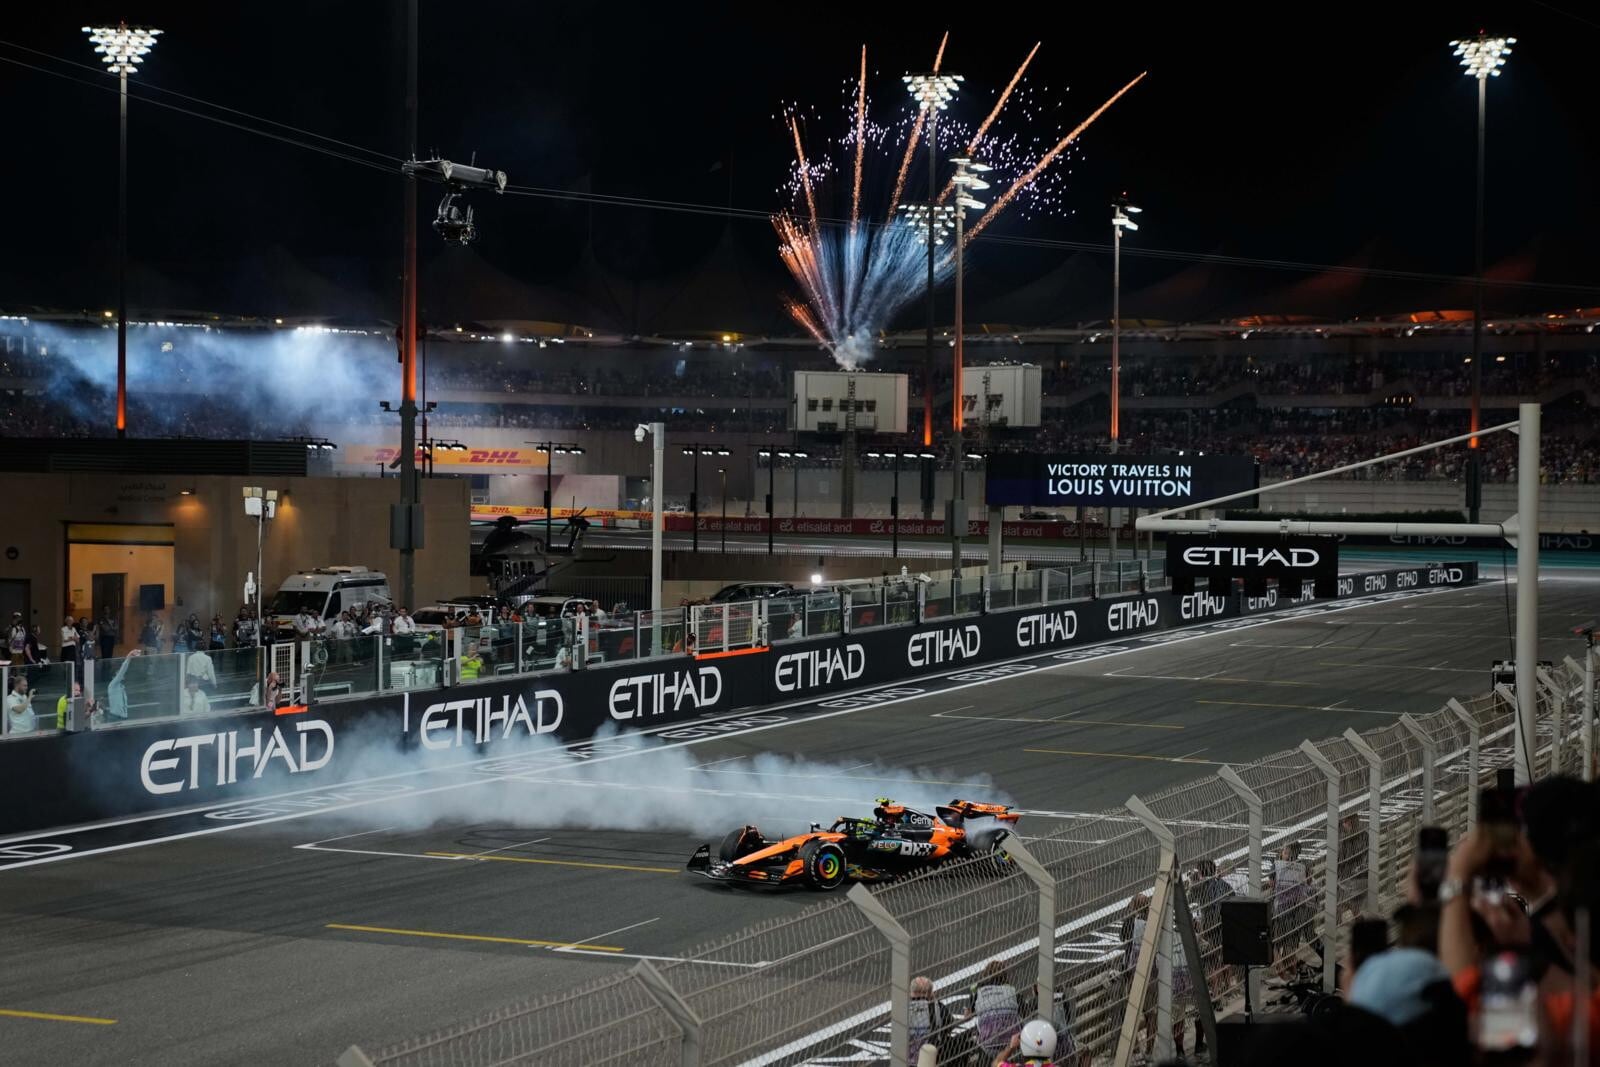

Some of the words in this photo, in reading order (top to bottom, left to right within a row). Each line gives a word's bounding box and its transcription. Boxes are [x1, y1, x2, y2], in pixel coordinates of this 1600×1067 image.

[375, 448, 427, 462] DL
[469, 450, 522, 463] DHL
[1047, 464, 1107, 476] VICTORY
[1111, 464, 1170, 477] TRAVELS
[1175, 465, 1192, 477] IN
[1048, 478, 1104, 495] LOUIS
[1109, 479, 1192, 496] VUITTON
[797, 520, 831, 532] etisalat
[832, 520, 852, 533] and
[888, 522, 924, 534] eisalat
[926, 523, 944, 534] and
[1540, 535, 1593, 549] IHAD
[1183, 546, 1319, 567] ETIHAD
[1364, 574, 1387, 592] ETIHAD
[1397, 571, 1418, 588] ETIHAD
[1429, 568, 1463, 583] ETIHAD
[1107, 598, 1159, 632] ETIHAD
[1017, 610, 1077, 647] ETIHAD
[907, 625, 981, 667] ETIHAD
[775, 643, 865, 692] ETIHAD
[608, 666, 723, 720] ETIHAD
[420, 689, 564, 750] ETIHAD
[140, 719, 334, 795] ETIHAD
